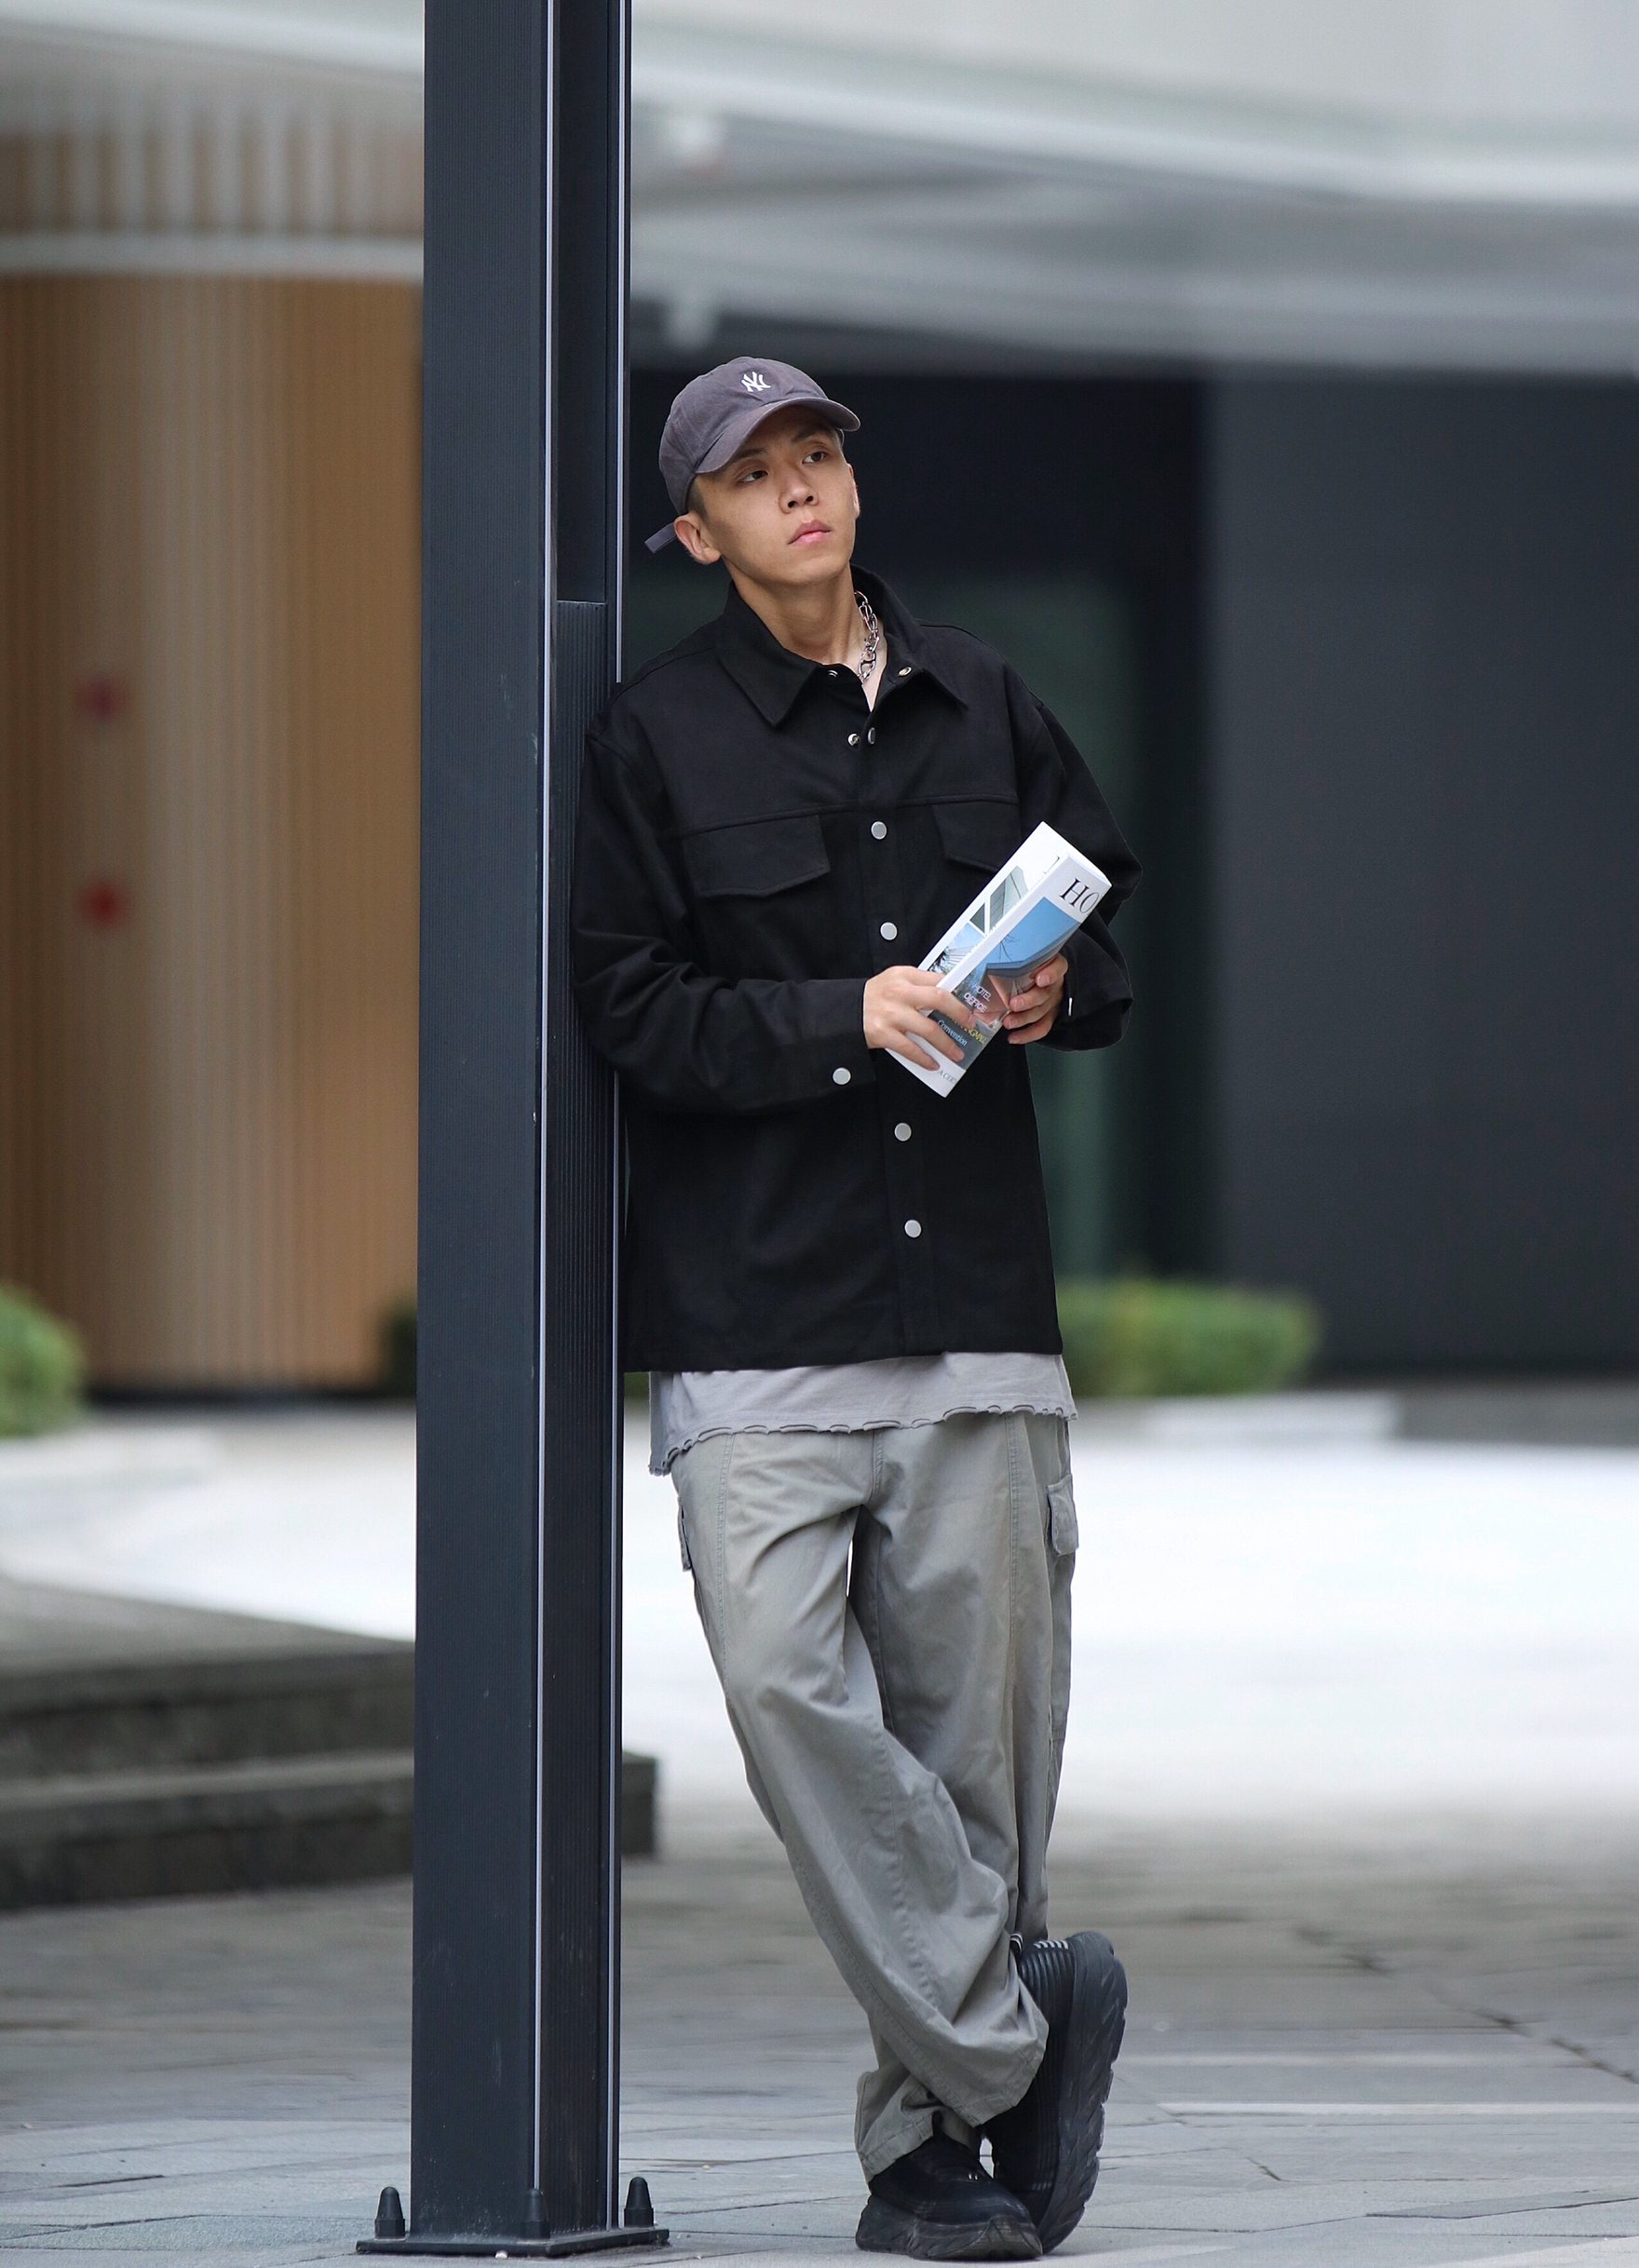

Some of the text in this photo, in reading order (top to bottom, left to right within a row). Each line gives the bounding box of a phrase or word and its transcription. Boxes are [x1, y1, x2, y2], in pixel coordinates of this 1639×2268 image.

[741, 371, 771, 392] NY
[964, 992, 988, 1013] OFFICE
[972, 983, 992, 1002] HOTEL
[938, 1019, 968, 1046] Convention
